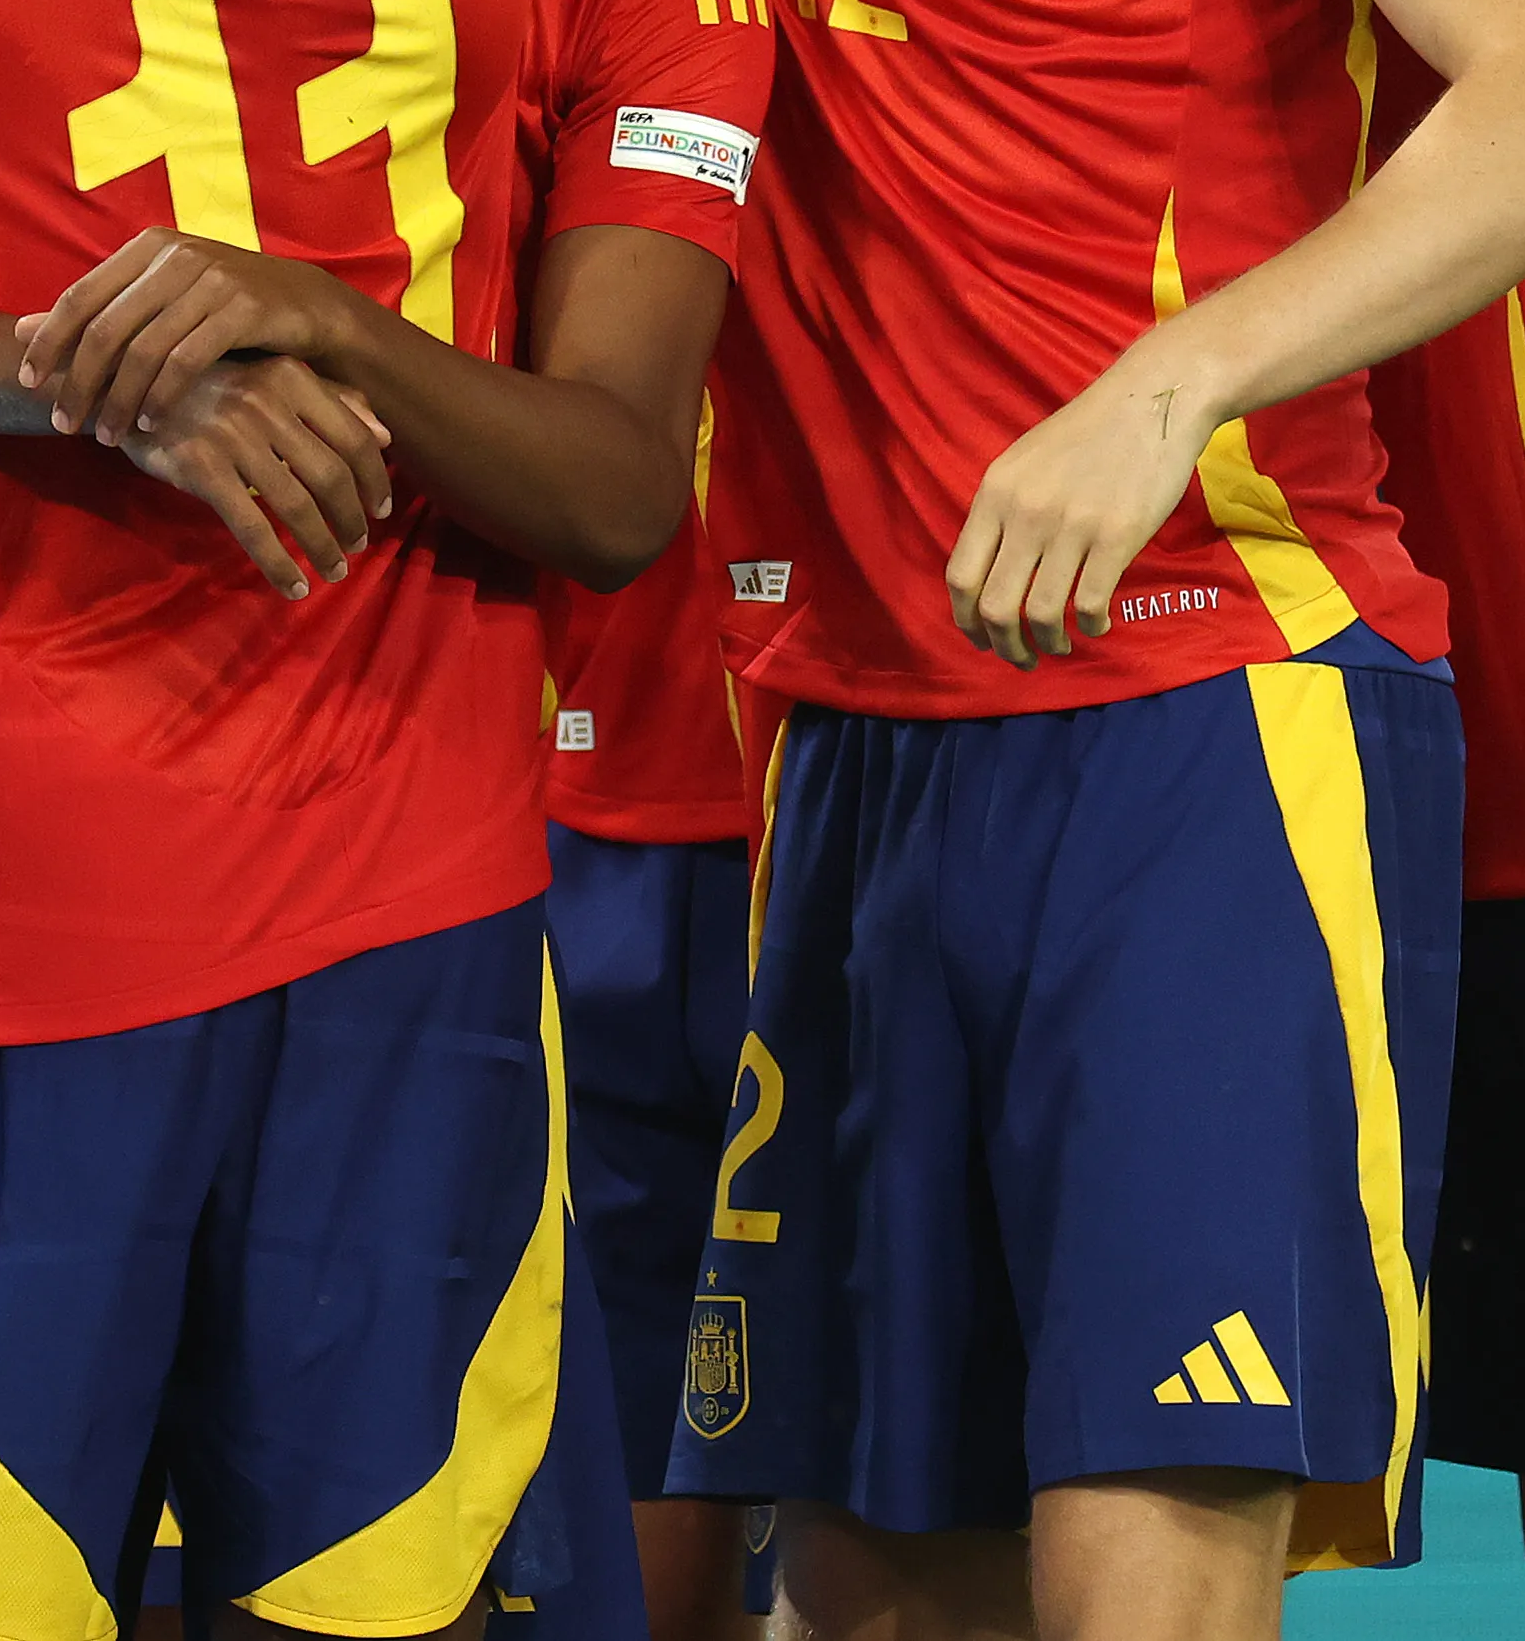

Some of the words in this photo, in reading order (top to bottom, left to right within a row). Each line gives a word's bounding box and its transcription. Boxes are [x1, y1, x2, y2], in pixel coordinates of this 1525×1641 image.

[619, 112, 654, 124] UEFA
[617, 130, 740, 168] FOUNDATION
[695, 164, 709, 176] for
[1121, 586, 1219, 623] HEAT.RDY
[712, 1030, 784, 1243] 2
